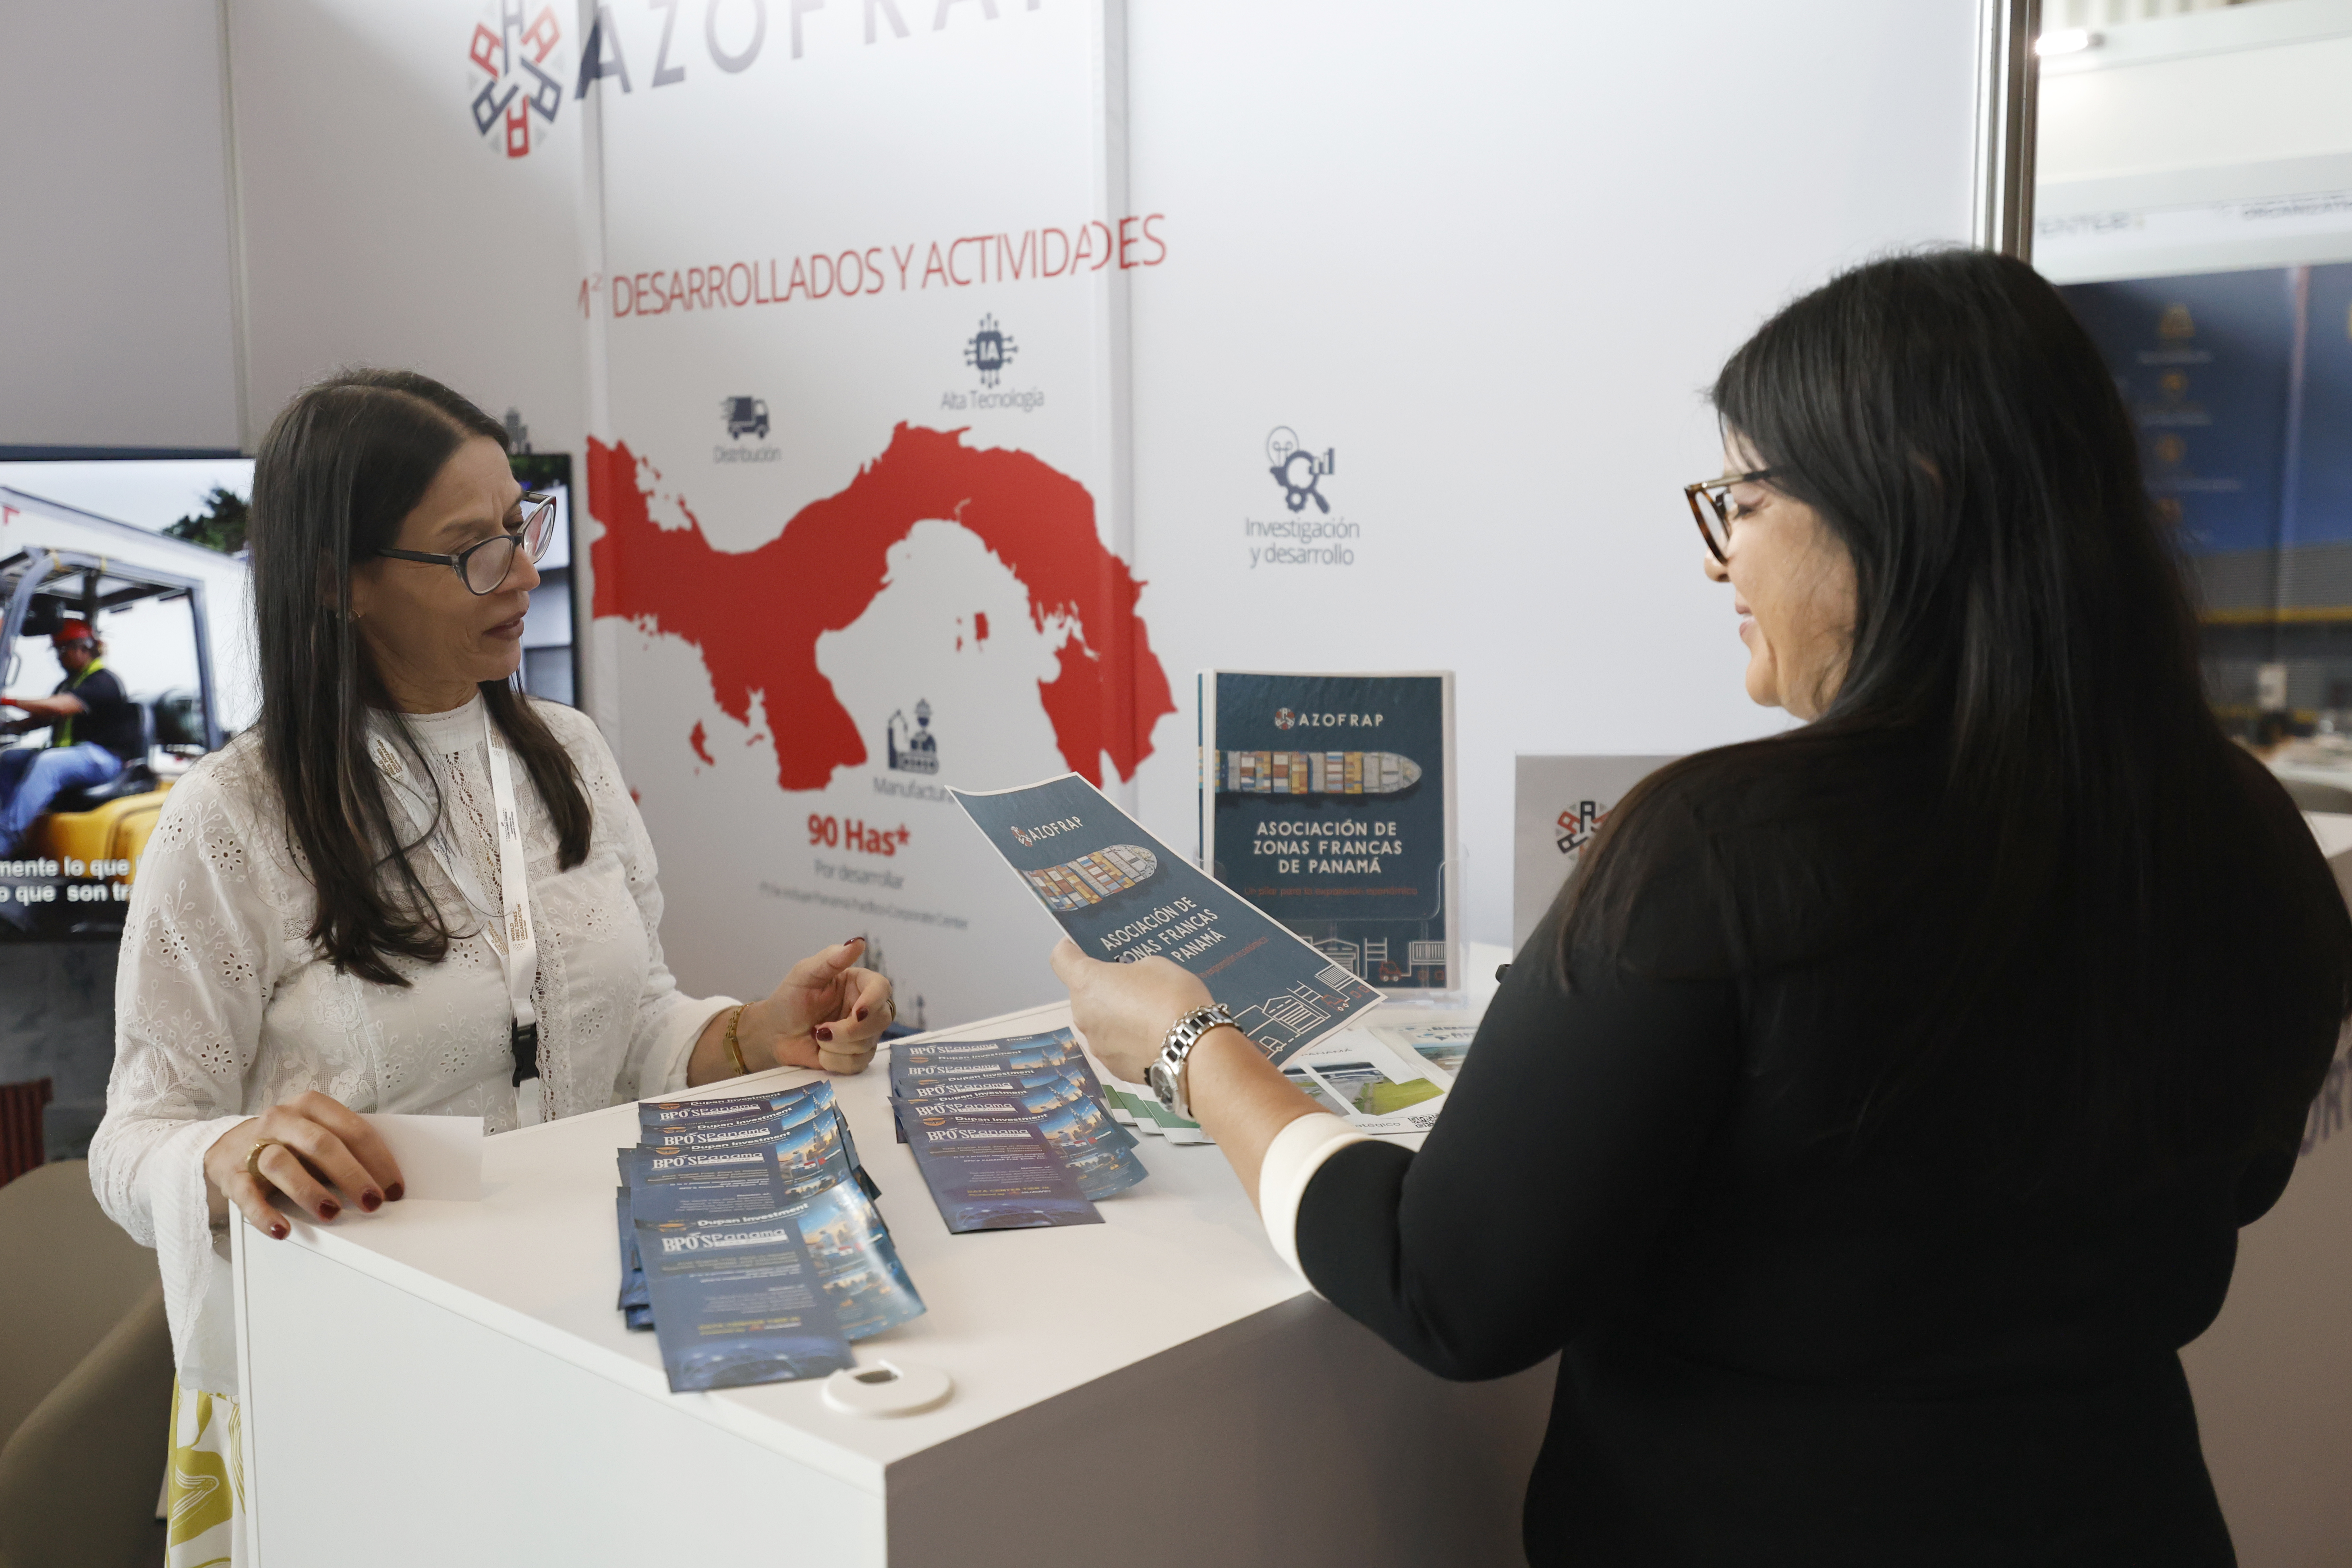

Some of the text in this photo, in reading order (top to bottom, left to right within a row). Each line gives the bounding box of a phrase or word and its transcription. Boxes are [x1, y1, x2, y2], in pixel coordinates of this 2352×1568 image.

[574, 0, 1042, 100] AZOF
[612, 246, 884, 318] DESARROLLADOS
[891, 242, 915, 291] Y
[921, 213, 1167, 289] ACTIVIDADES
[979, 340, 1001, 362] IA
[969, 386, 1046, 412] Tecnología
[1245, 516, 1361, 544] Investigación
[1250, 542, 1354, 569] y desarrollo
[1299, 713, 1384, 727] AZOFRAP
[808, 812, 838, 848] 90
[1028, 816, 1084, 841] AZOFRAP
[1257, 818, 1397, 836] ASOCIACIÓN DE
[1254, 841, 1402, 855] ZONAS FRANCAS
[63, 855, 86, 877] lo
[89, 858, 130, 880] que
[1279, 856, 1382, 874] DE PANAMÁ
[15, 884, 57, 907] que
[66, 884, 109, 902] son
[517, 904, 526, 940] ORGANIZATION
[1100, 896, 1197, 951] ASOCIACIÓN DE
[1157, 909, 1218, 945] FRANCAS
[1171, 927, 1227, 963] PANAMÁ
[972, 1050, 1022, 1059] Investment
[982, 1069, 1035, 1078] Investment
[939, 1089, 1028, 1102] Dupan Investment
[955, 1082, 1011, 1091] Panama
[727, 1092, 781, 1104] Investment
[700, 1104, 759, 1113] Panama
[736, 1107, 793, 1125] Investment
[992, 1114, 1048, 1122] Investment
[691, 1131, 792, 1151] Dupan Investment
[707, 1127, 769, 1139] Panama
[697, 1152, 763, 1161] Panama
[697, 1203, 809, 1227] Dupan Investment
[711, 1228, 786, 1242] Panama
